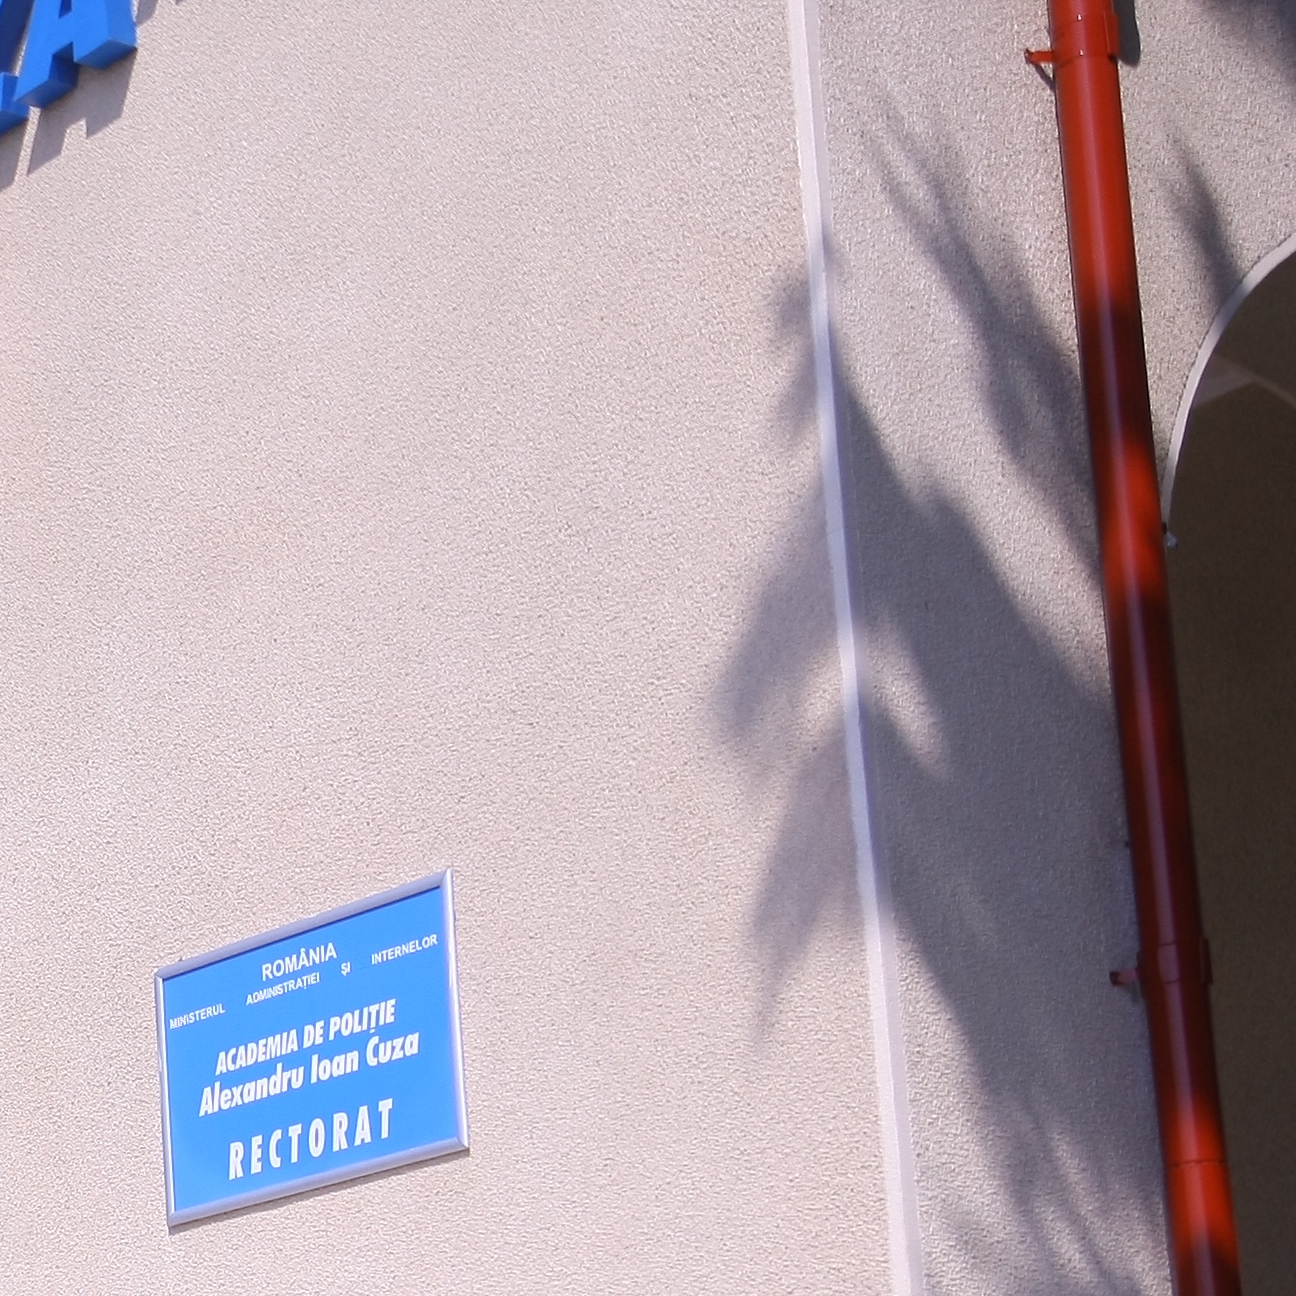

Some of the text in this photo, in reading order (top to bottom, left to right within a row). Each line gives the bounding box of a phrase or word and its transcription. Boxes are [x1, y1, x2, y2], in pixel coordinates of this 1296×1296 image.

[169, 1003, 226, 1029] MINISTERUL
[371, 933, 438, 965] INTERNELOR
[261, 942, 337, 981] ROMÂNIA
[199, 1032, 420, 1117] Alexandru Ioan Cuza
[215, 1029, 298, 1076] ACADEMIA
[303, 1023, 324, 1049] DE
[228, 1098, 393, 1180] RECTORAT
